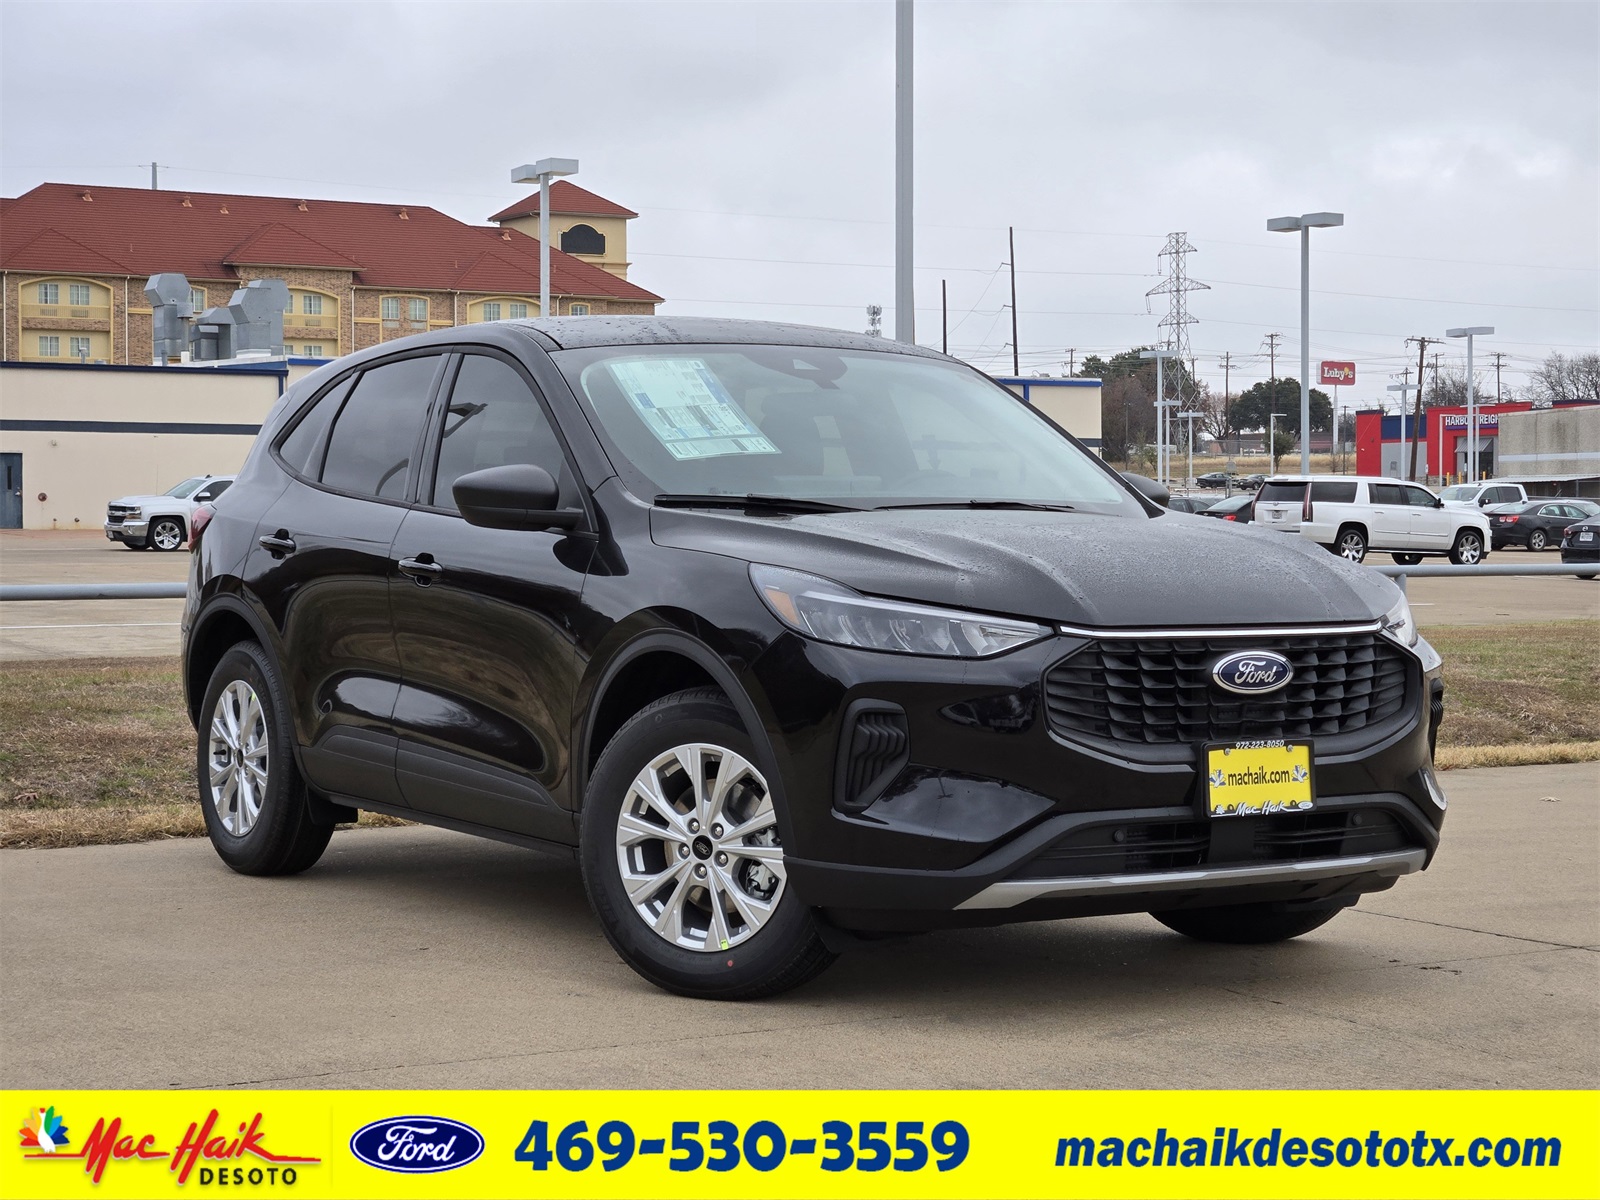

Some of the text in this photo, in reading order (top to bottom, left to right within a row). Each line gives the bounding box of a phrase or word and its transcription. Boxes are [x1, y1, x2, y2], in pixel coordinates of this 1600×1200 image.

[1323, 366, 1354, 381] Luby's
[1445, 415, 1472, 426] HARBO
[1234, 660, 1277, 684] Ford
[1235, 739, 1285, 750] 972-223-8050
[1227, 766, 1290, 787] machaik.com
[1235, 800, 1290, 817] Mac Haik
